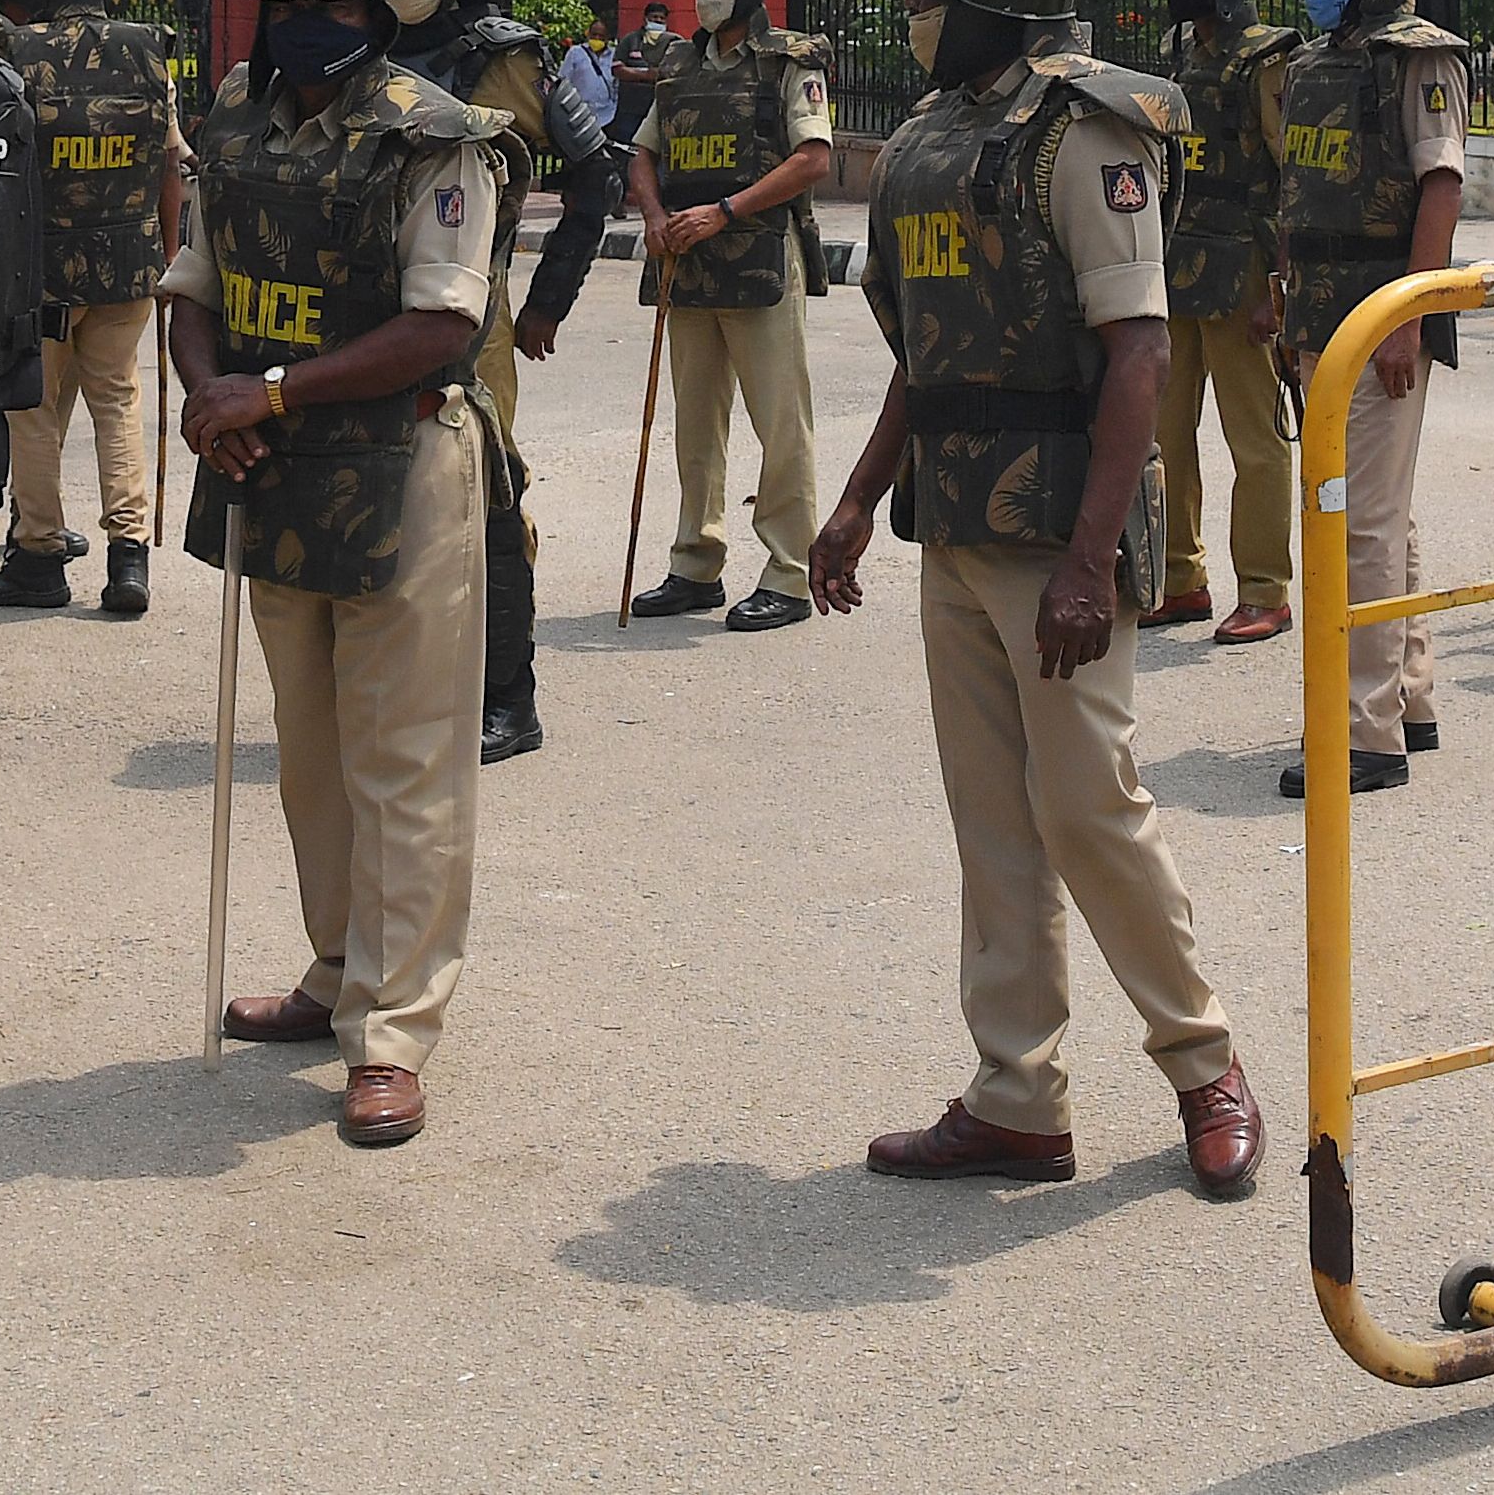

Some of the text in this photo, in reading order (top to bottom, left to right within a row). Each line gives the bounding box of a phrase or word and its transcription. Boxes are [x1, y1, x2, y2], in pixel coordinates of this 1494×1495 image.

[51, 135, 136, 170] POLICE
[669, 134, 737, 171] POLICE
[1283, 124, 1352, 171] POLICE
